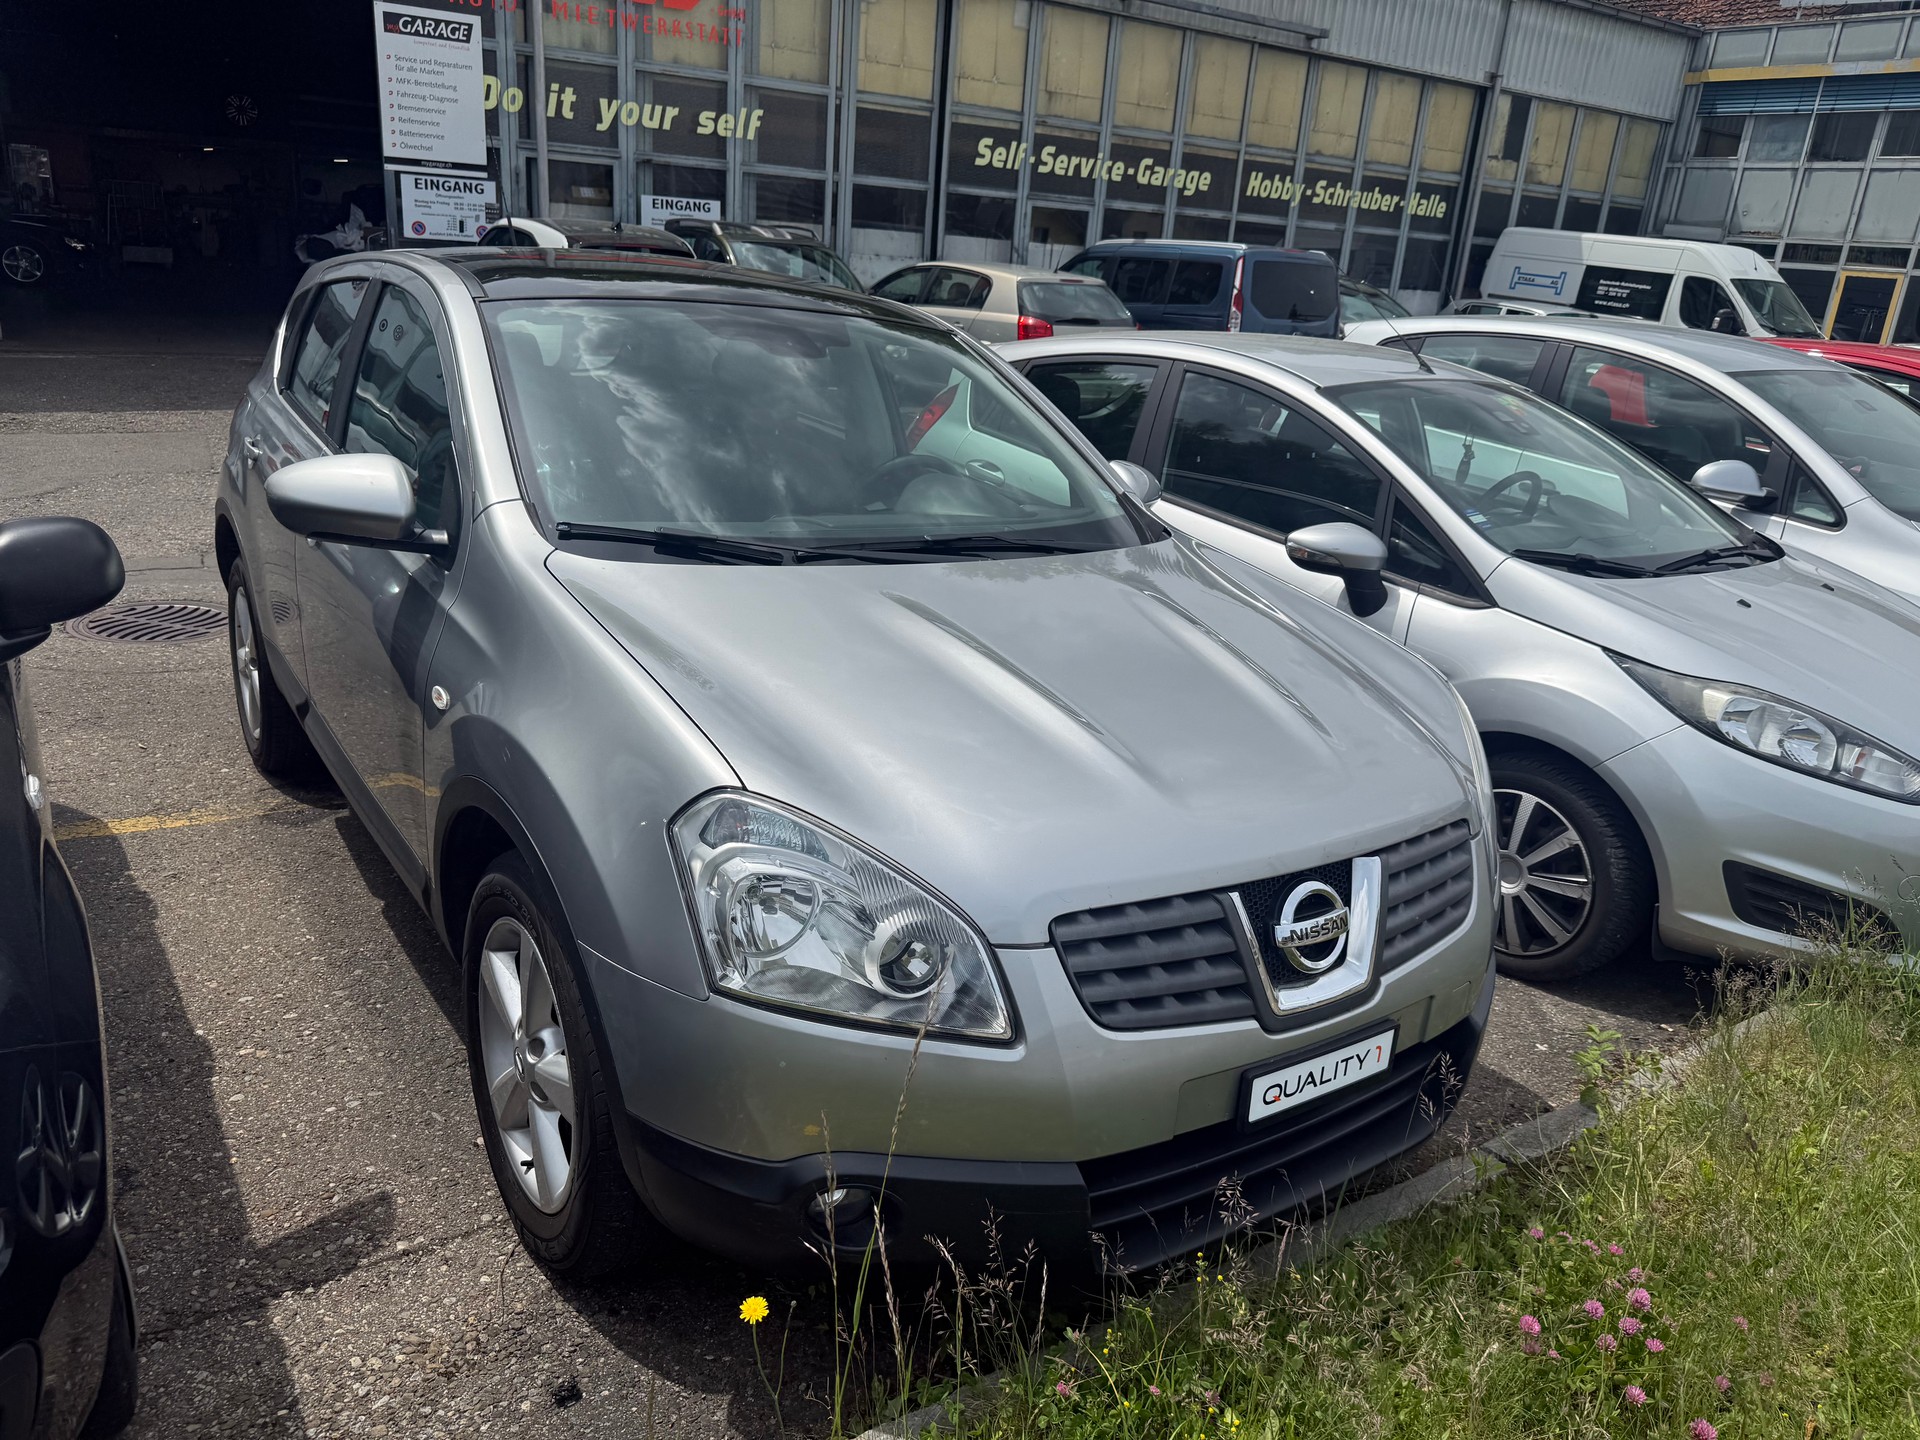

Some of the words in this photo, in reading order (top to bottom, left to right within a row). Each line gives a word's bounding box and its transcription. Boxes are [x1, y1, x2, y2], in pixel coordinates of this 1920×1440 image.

[394, 54, 418, 64] Service
[419, 57, 432, 66] und
[433, 60, 473, 71] Reparaturen
[394, 64, 404, 72] für
[406, 65, 418, 74] alle
[419, 67, 445, 77] Marken
[396, 90, 459, 104] Fahrzeug-Diagnose
[397, 103, 447, 115] Bremsenservice
[483, 74, 524, 113] Do
[546, 83, 578, 120] it
[596, 97, 680, 131] your
[696, 107, 764, 141] self
[398, 116, 441, 127] Reifenservice
[398, 129, 445, 140] Batterieservice
[399, 141, 434, 152] Ölwechsel
[414, 177, 485, 195] EINGANG
[652, 198, 711, 213] EINGANG
[1289, 915, 1350, 943] NISSAN
[1262, 1049, 1371, 1106] QUALITY
